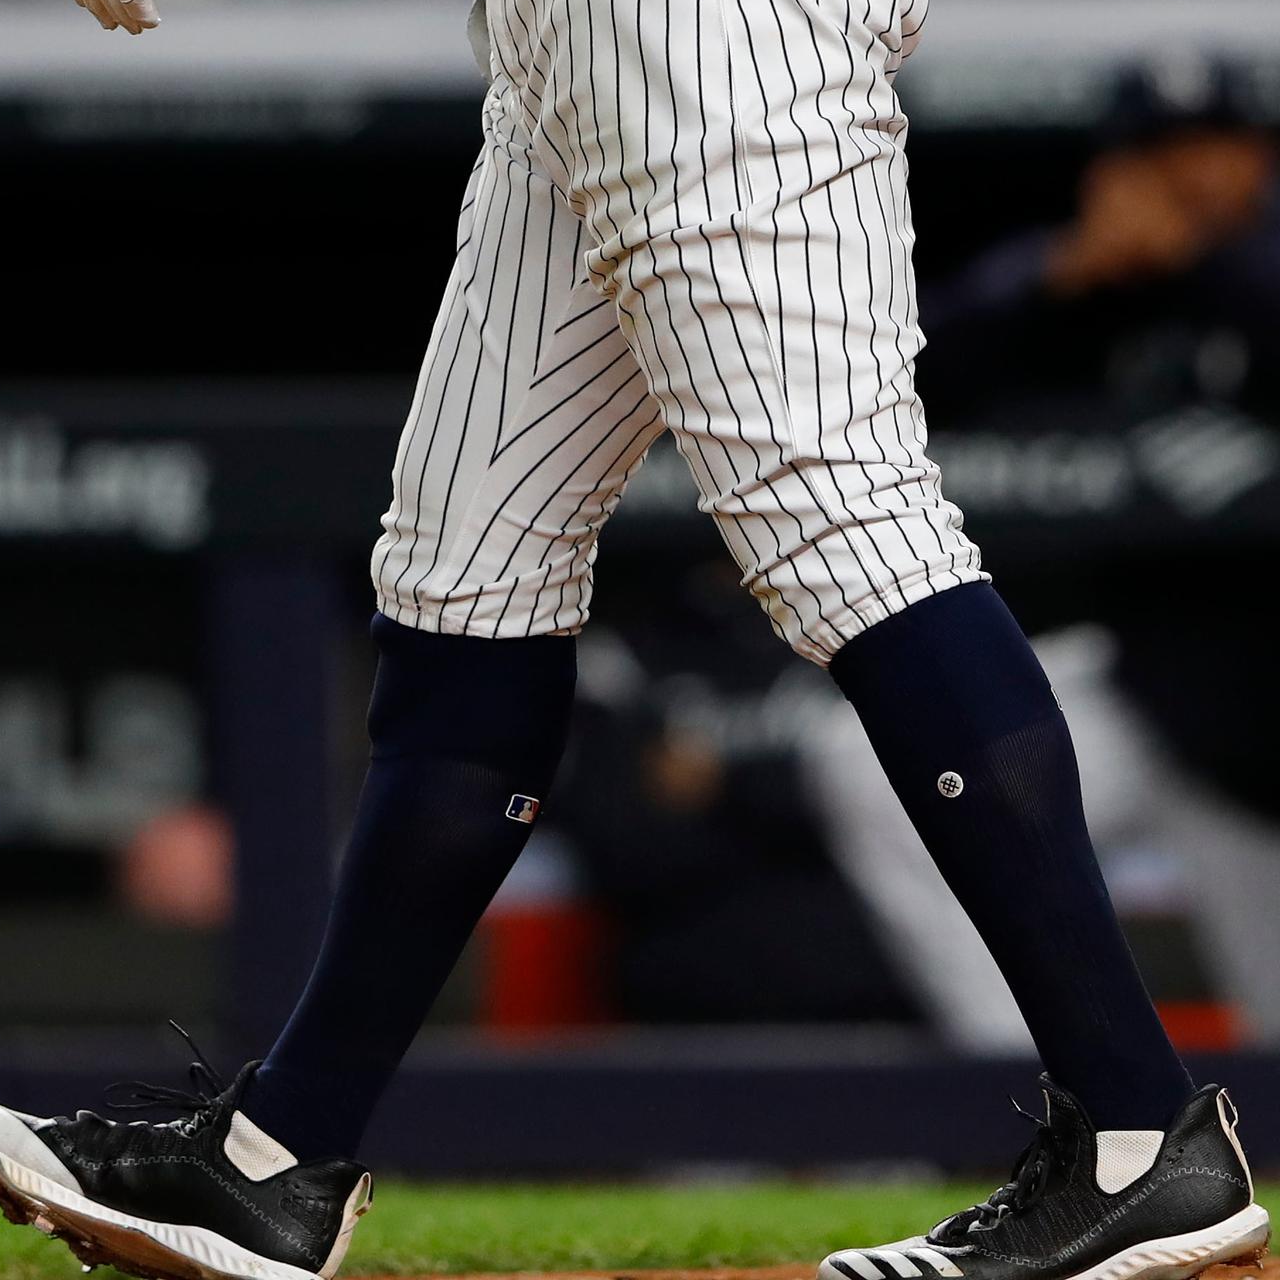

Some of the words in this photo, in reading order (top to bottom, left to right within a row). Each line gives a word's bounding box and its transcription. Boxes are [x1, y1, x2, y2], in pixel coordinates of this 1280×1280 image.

[1057, 1223, 1103, 1262] PROTECT
[1103, 1204, 1128, 1224] THE
[1127, 1181, 1158, 1206] WALL
